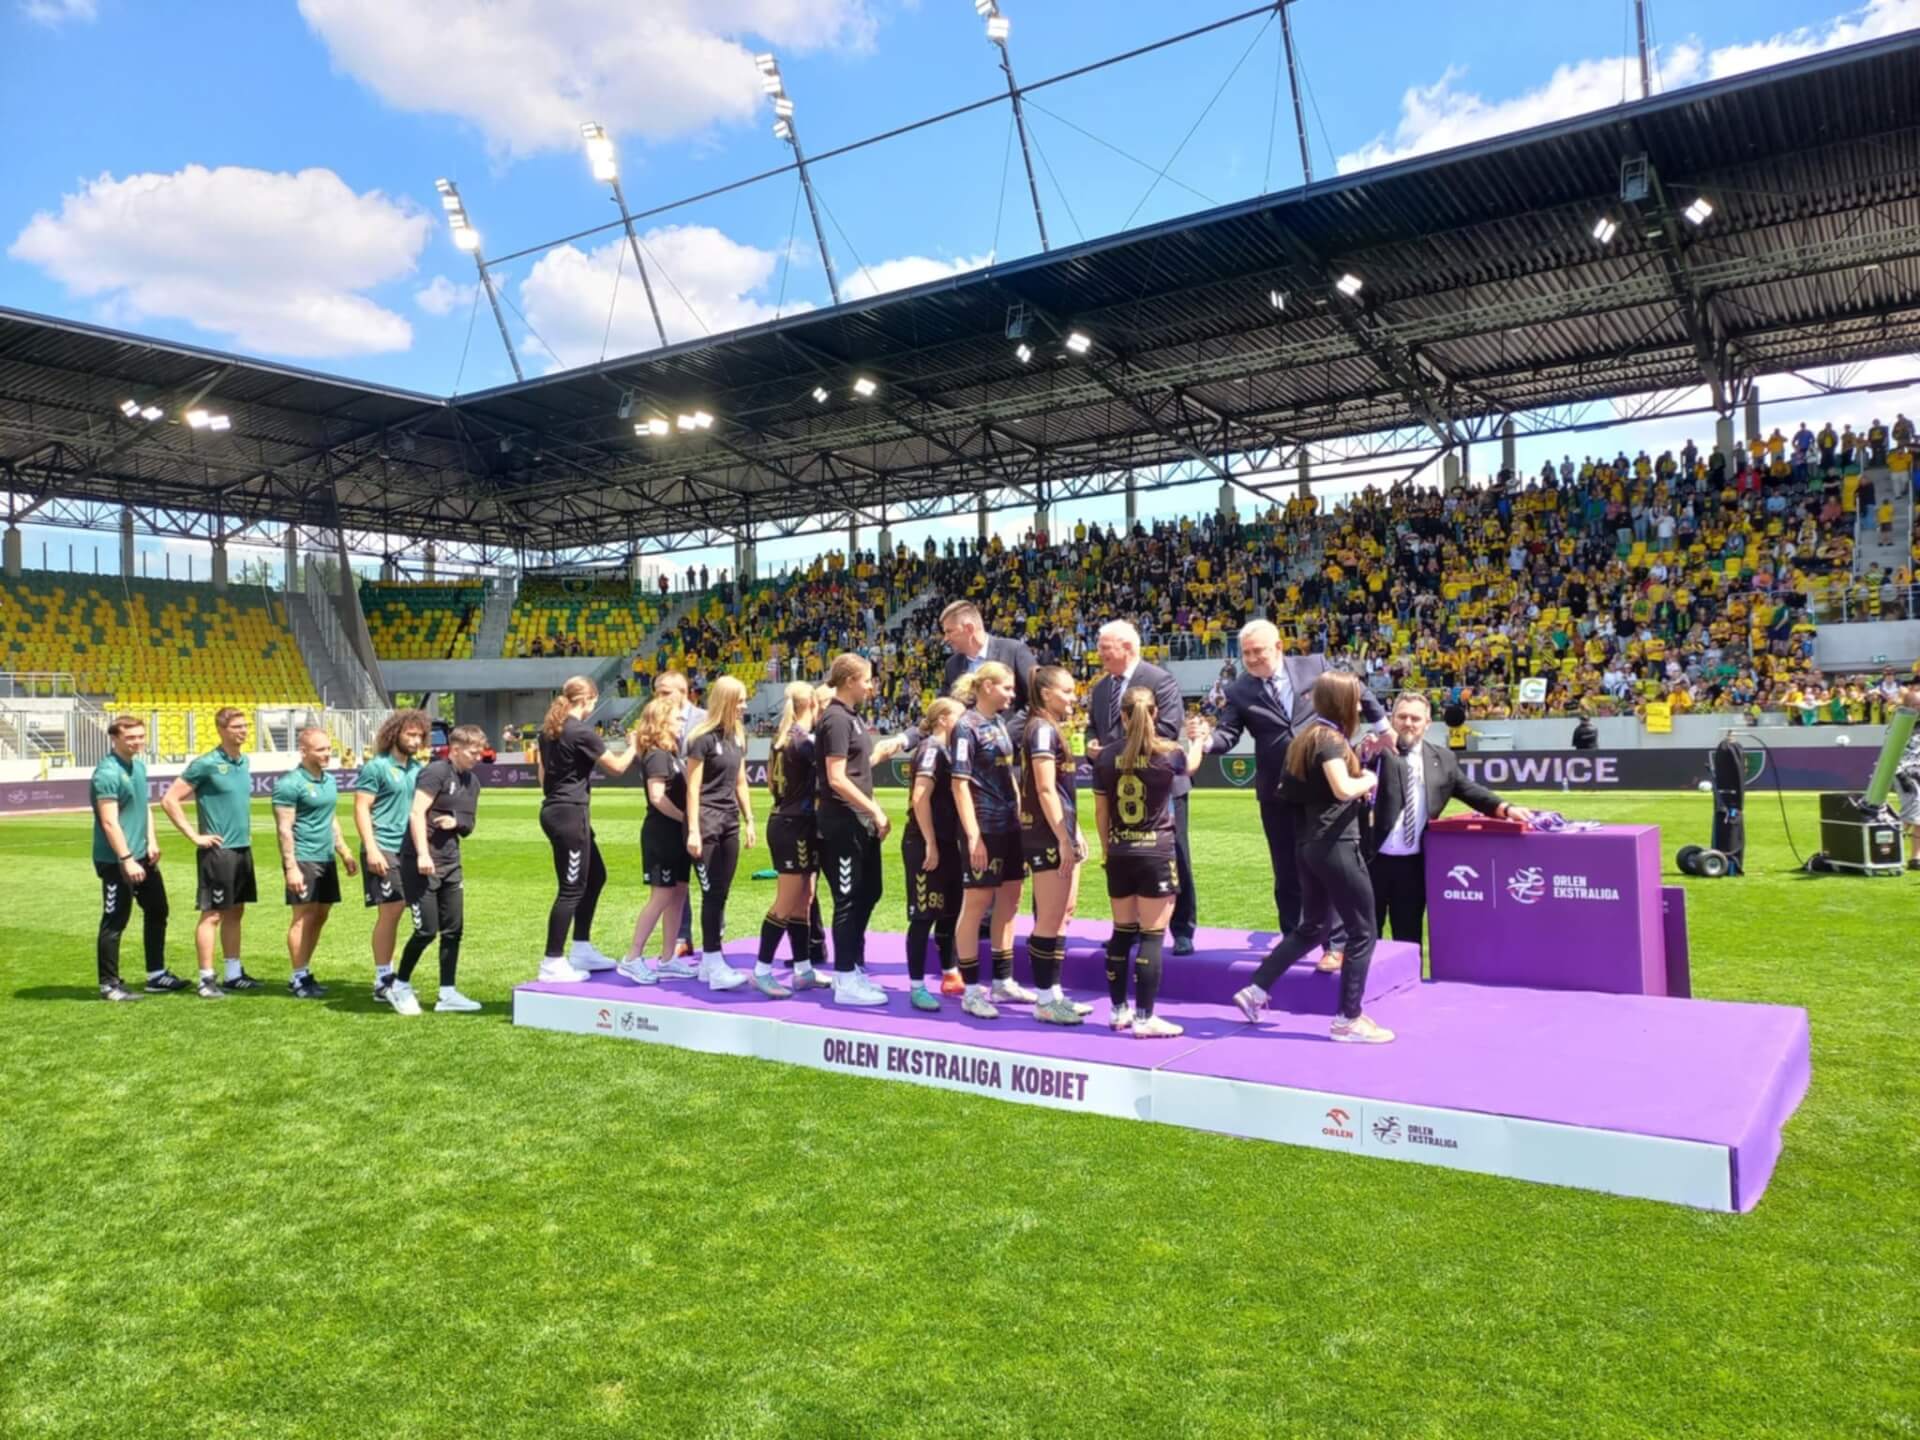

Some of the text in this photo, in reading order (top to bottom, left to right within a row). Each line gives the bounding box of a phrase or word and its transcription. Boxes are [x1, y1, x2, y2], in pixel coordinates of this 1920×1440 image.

[1459, 757, 1619, 782] TOWICE
[1116, 774, 1146, 825] 8
[1552, 875, 1587, 887] ORLEN
[1443, 890, 1484, 901] ORLEN
[1552, 887, 1620, 900] EKSTRALIGA
[823, 1037, 1089, 1102] ORLEN EKSTRALIGA KOBIET
[1322, 1127, 1353, 1139] ORLEN
[1407, 1125, 1434, 1136] ORLEN
[1407, 1134, 1458, 1149] EKSTRALIGA
